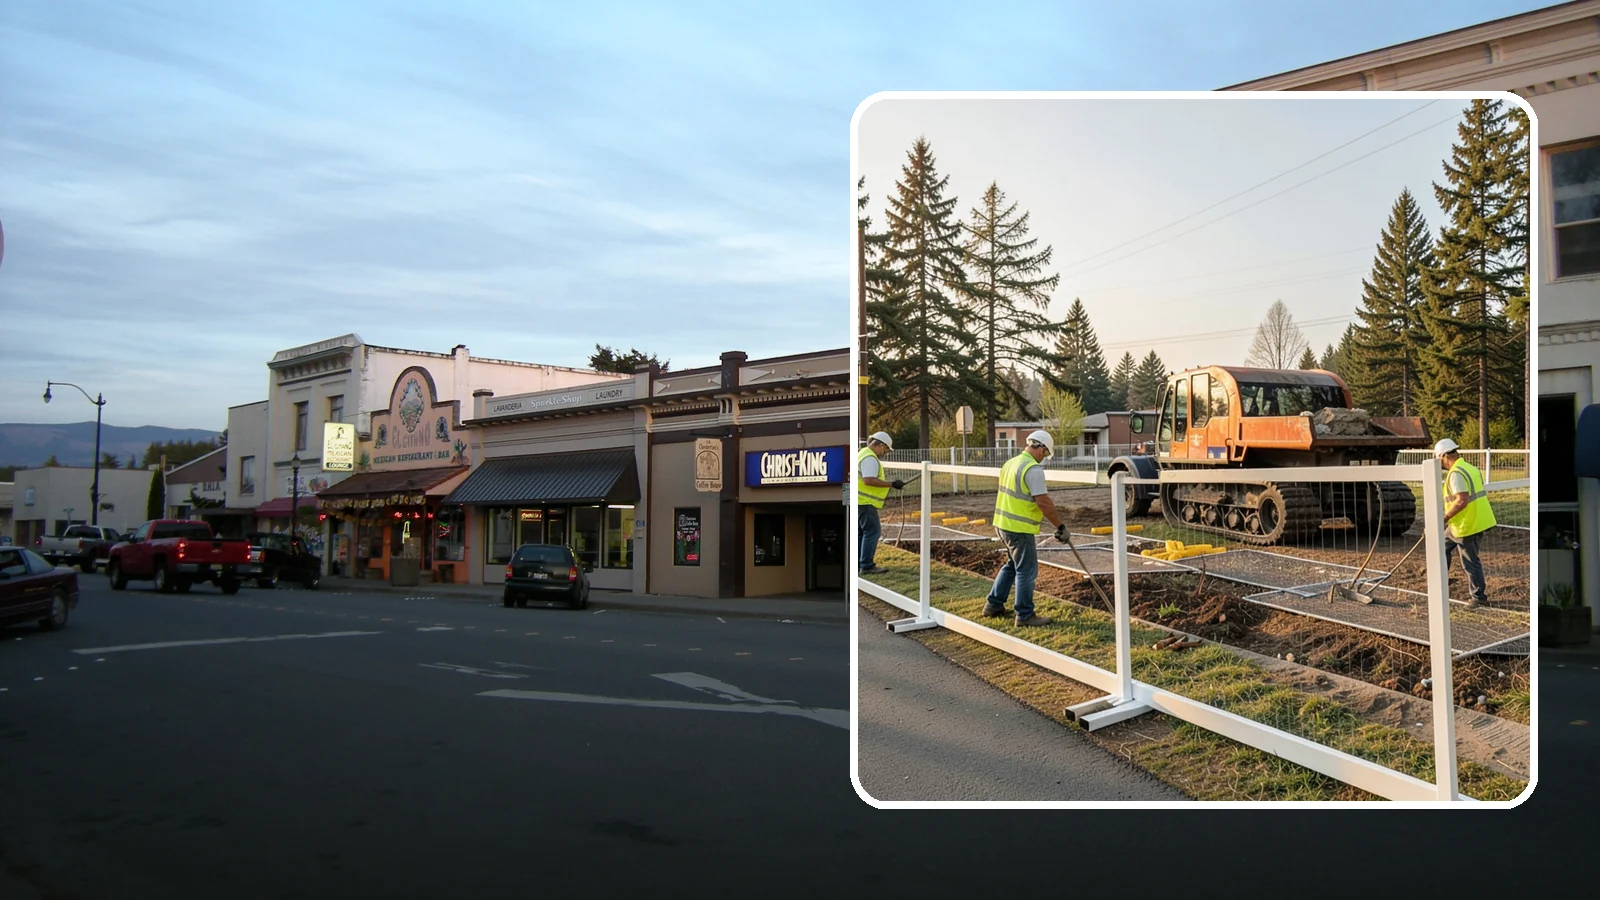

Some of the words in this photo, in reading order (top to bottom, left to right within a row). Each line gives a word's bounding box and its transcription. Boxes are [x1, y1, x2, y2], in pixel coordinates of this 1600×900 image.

[530, 397, 560, 409] Sparkle
[561, 394, 583, 405] Shop
[595, 389, 623, 400] LAUNDRY
[493, 402, 522, 412] LAVANDERIA
[373, 455, 396, 464] MEXICAN
[397, 451, 434, 462] RESTAURANT
[437, 450, 450, 459] BAR
[799, 450, 828, 477] KING
